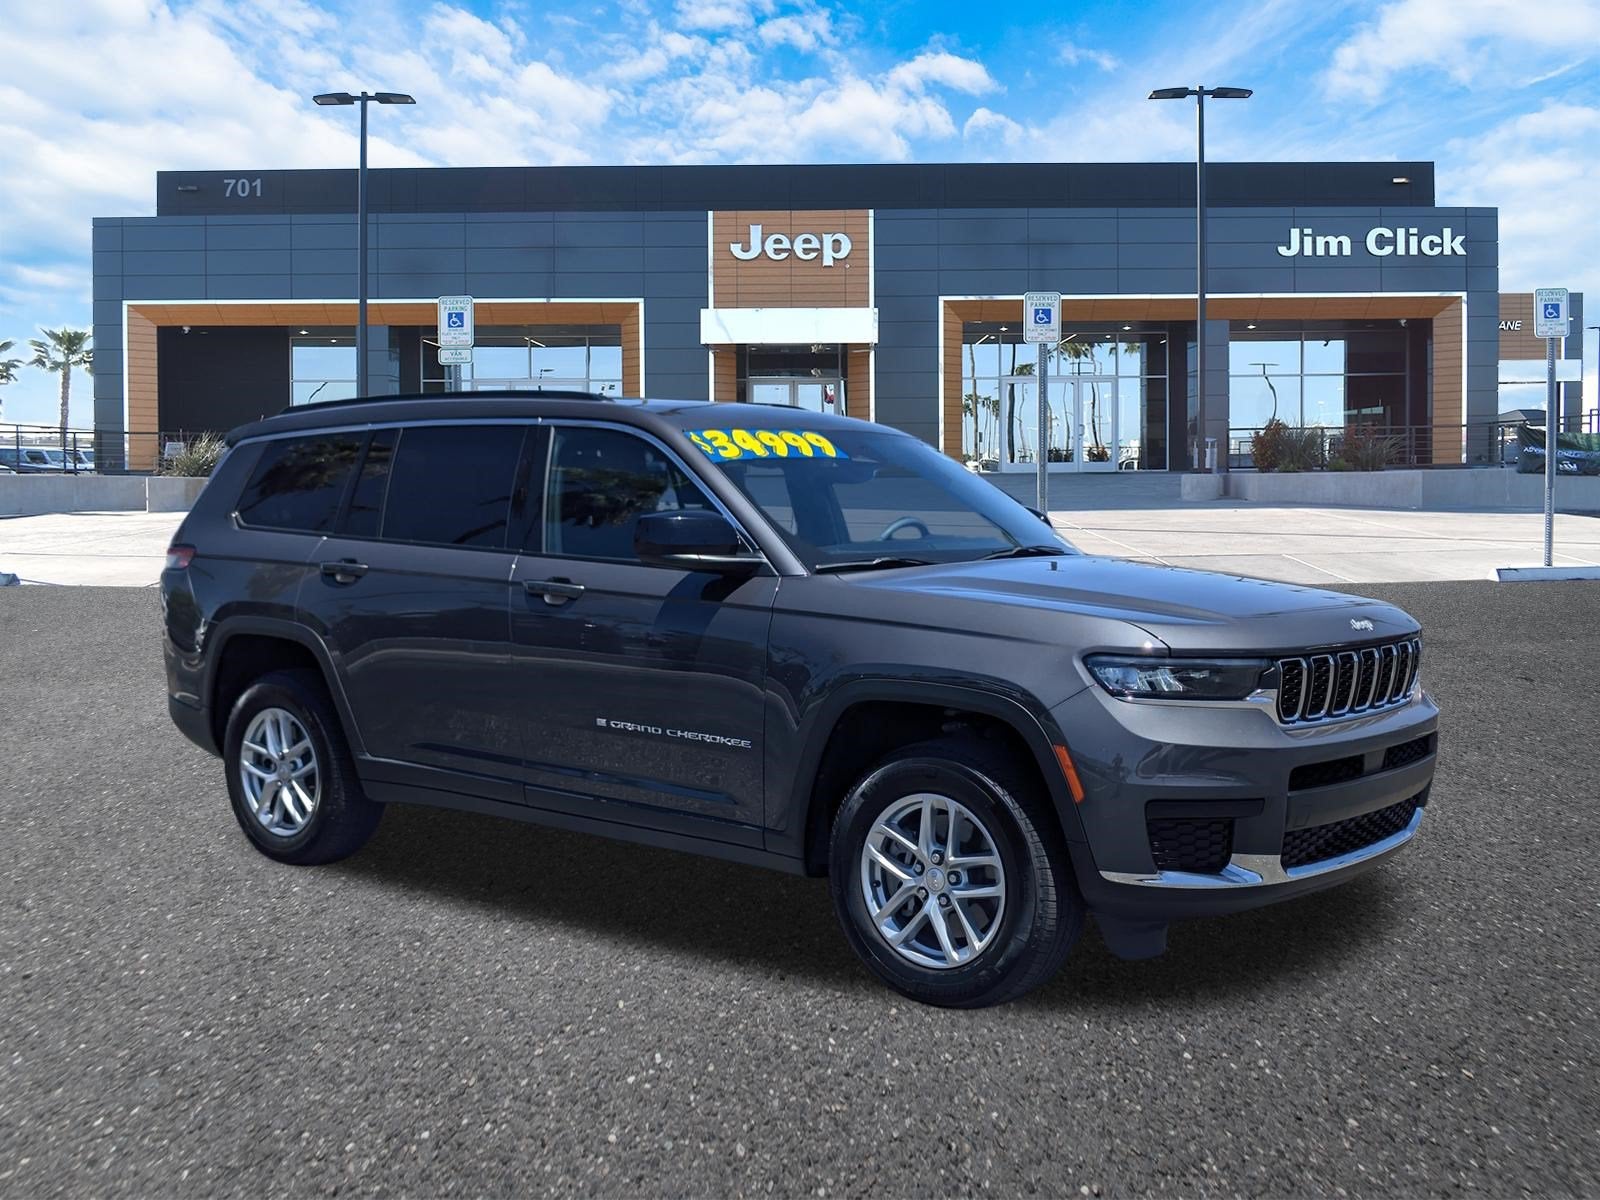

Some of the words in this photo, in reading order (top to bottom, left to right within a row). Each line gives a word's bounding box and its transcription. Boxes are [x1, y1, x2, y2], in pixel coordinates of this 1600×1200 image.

[223, 178, 261, 197] 701
[730, 224, 852, 267] Jeep
[1277, 228, 1351, 257] Jim
[1366, 227, 1467, 256] Click
[689, 428, 836, 459] $34999
[610, 720, 662, 735] GRAND
[666, 729, 752, 748] CHEROKEE
